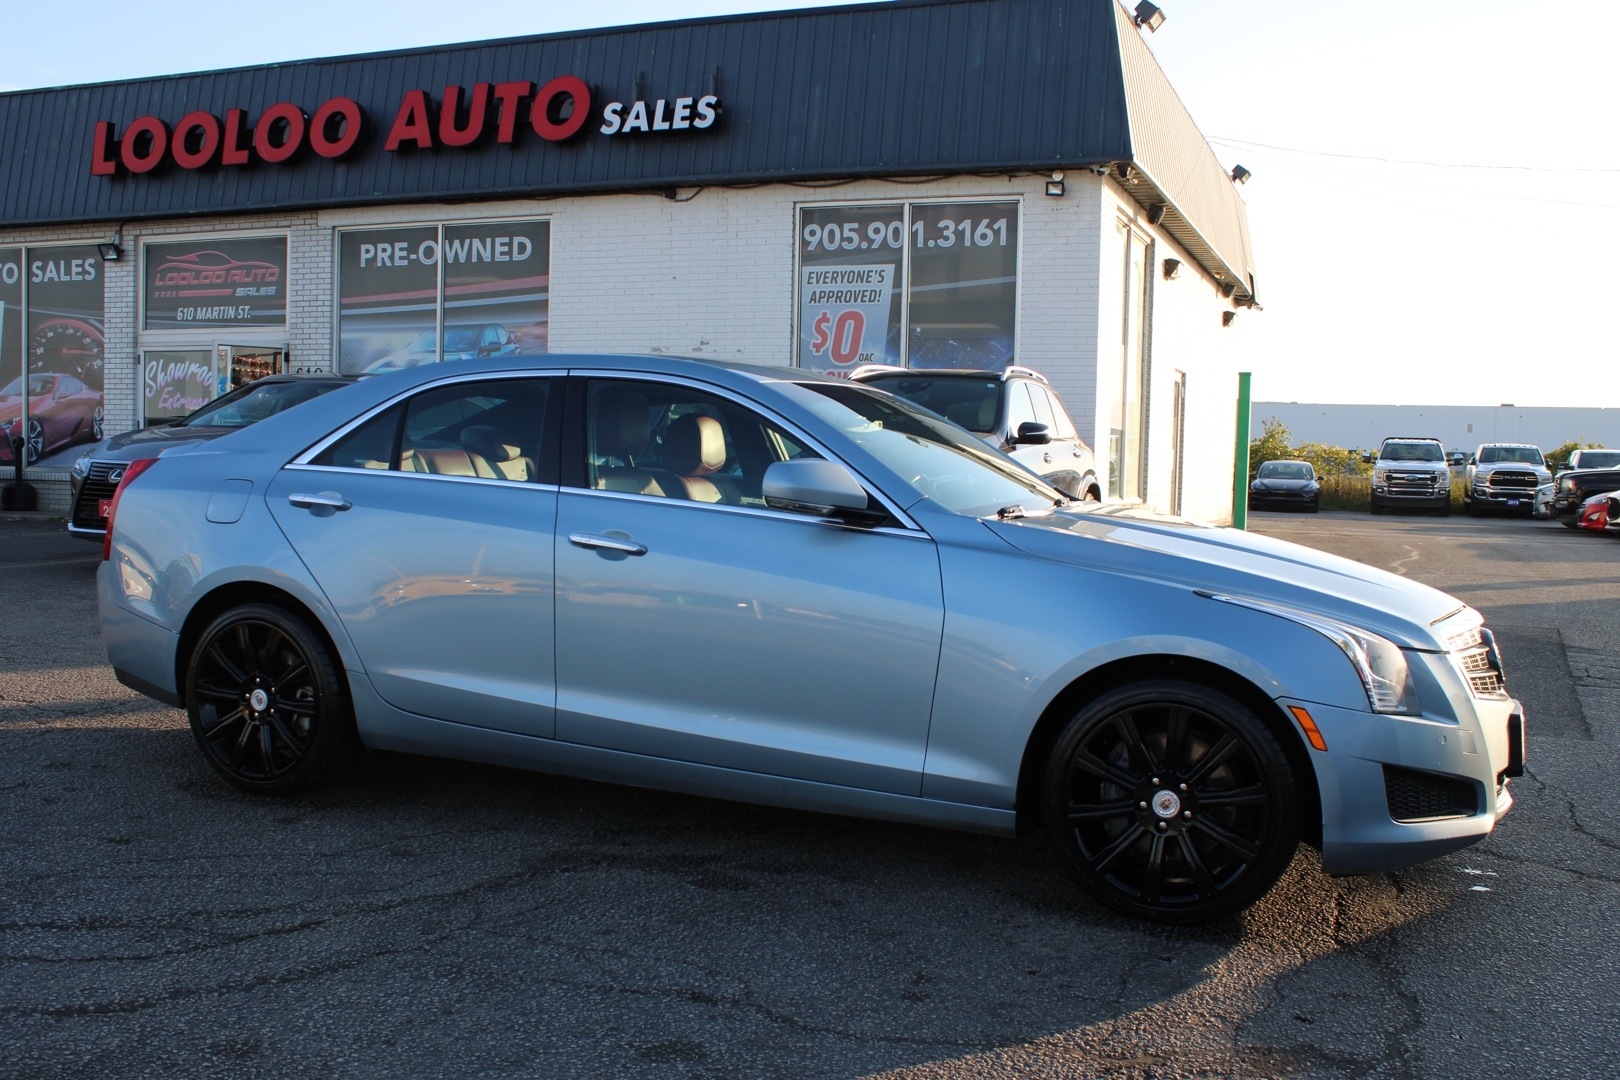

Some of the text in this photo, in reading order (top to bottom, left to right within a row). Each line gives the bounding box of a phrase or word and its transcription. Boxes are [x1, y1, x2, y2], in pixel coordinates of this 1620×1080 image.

[91, 75, 718, 175] LOOLOO AUTO SALES
[803, 218, 1008, 250] 905.901.3161
[360, 236, 533, 267] PRE-OWNED
[32, 258, 96, 283] SALES
[154, 268, 280, 286] LOOLOO AUTO
[806, 269, 886, 285] EVERYONE'S
[235, 286, 277, 296] SALES
[808, 289, 883, 305] APPROVED!
[177, 305, 251, 320] 610 MARTIN ST.
[812, 310, 865, 364] $0
[858, 353, 874, 362] OAC
[145, 359, 213, 397] Showroo
